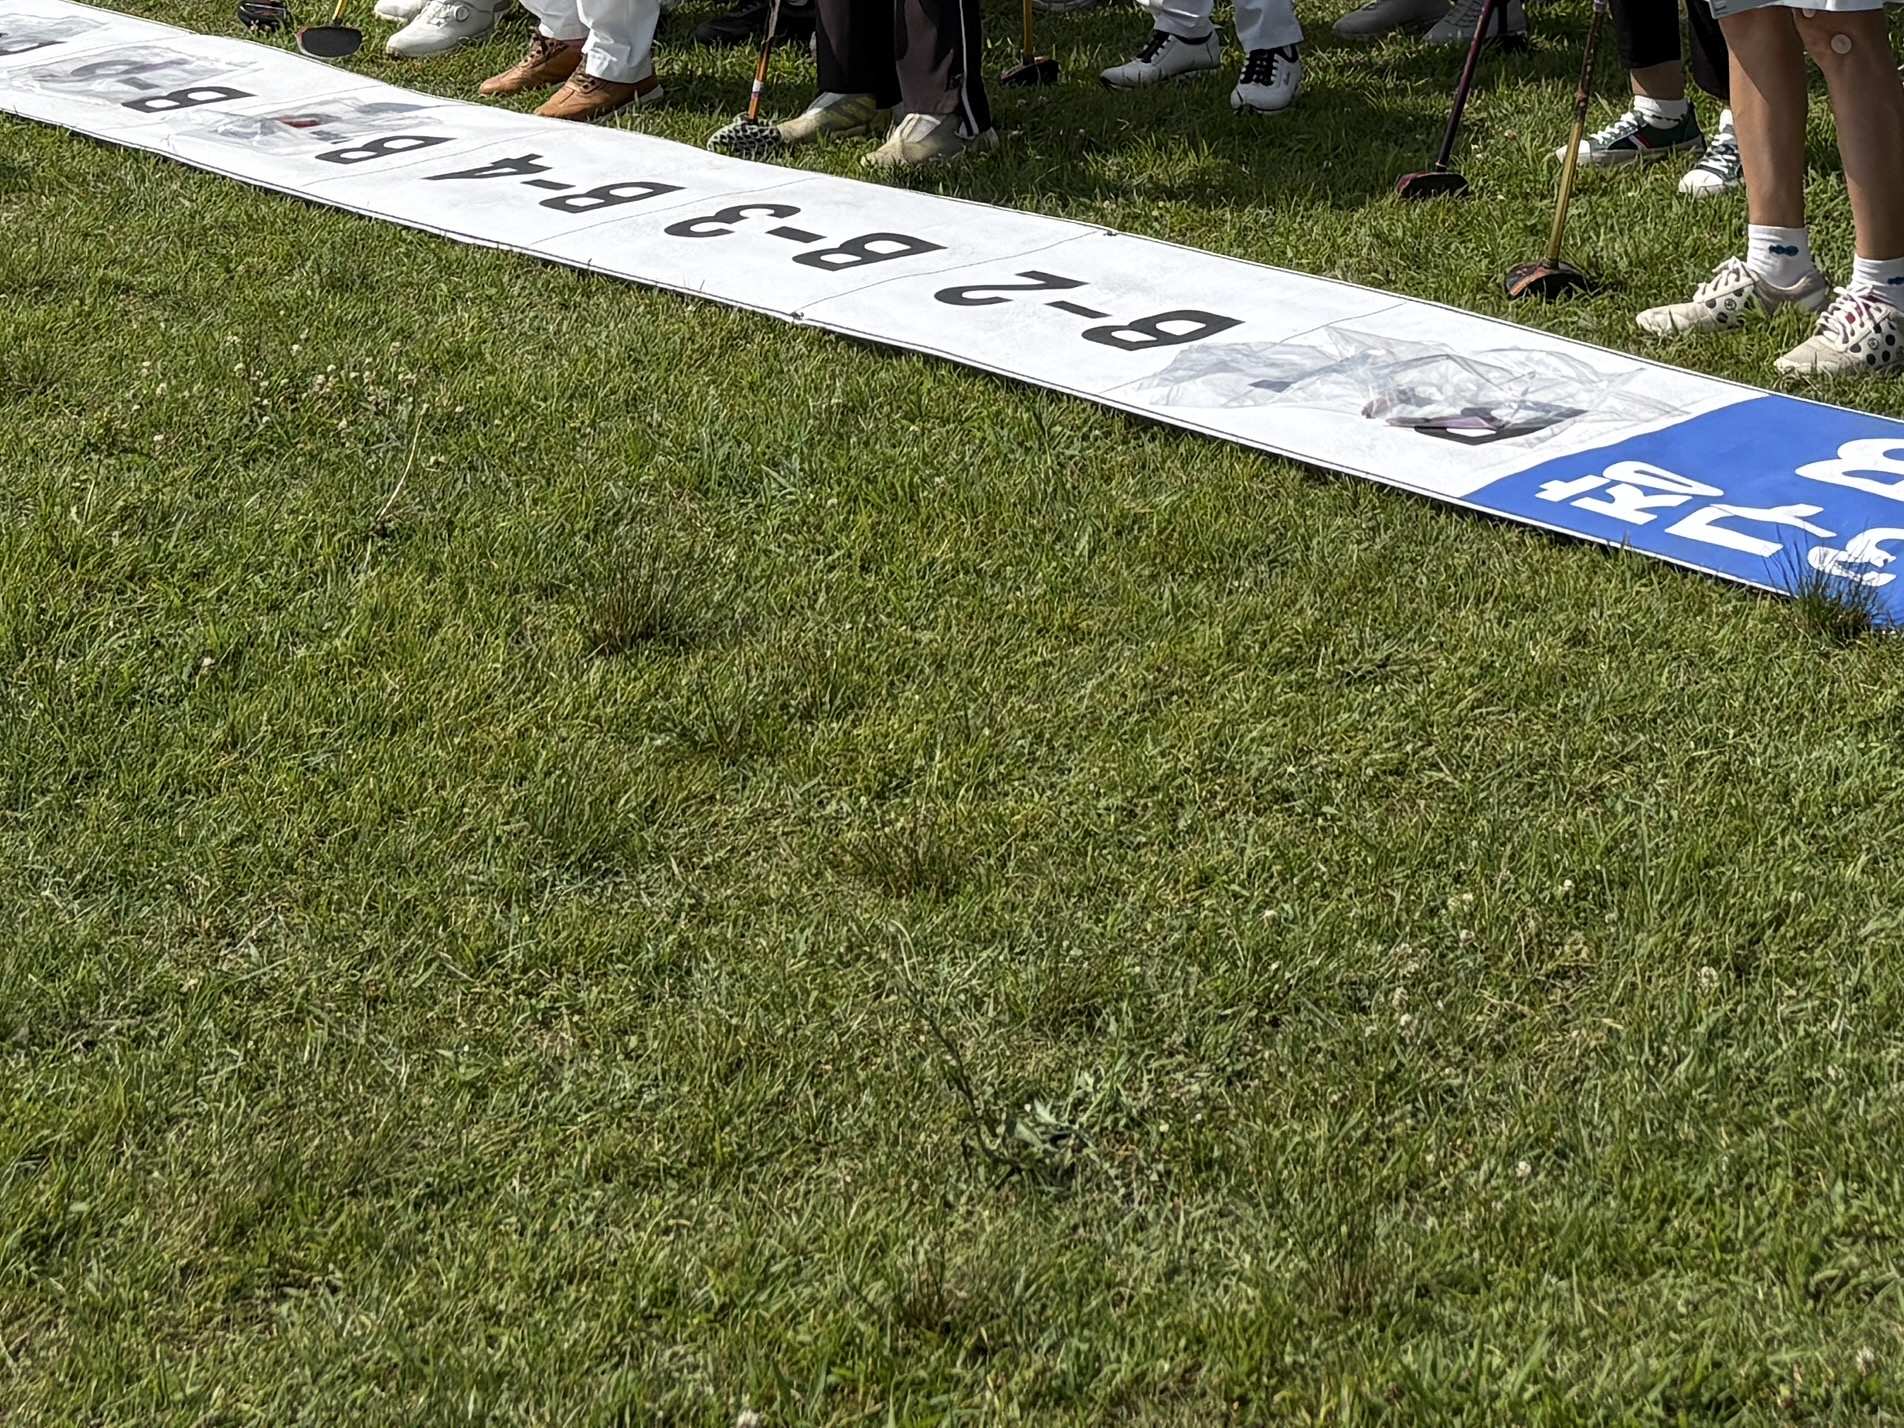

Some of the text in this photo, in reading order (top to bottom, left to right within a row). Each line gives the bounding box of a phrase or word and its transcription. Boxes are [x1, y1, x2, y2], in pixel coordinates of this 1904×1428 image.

[424, 152, 686, 215] B-4
[663, 202, 948, 273] B-3
[933, 269, 1245, 353] B-2
